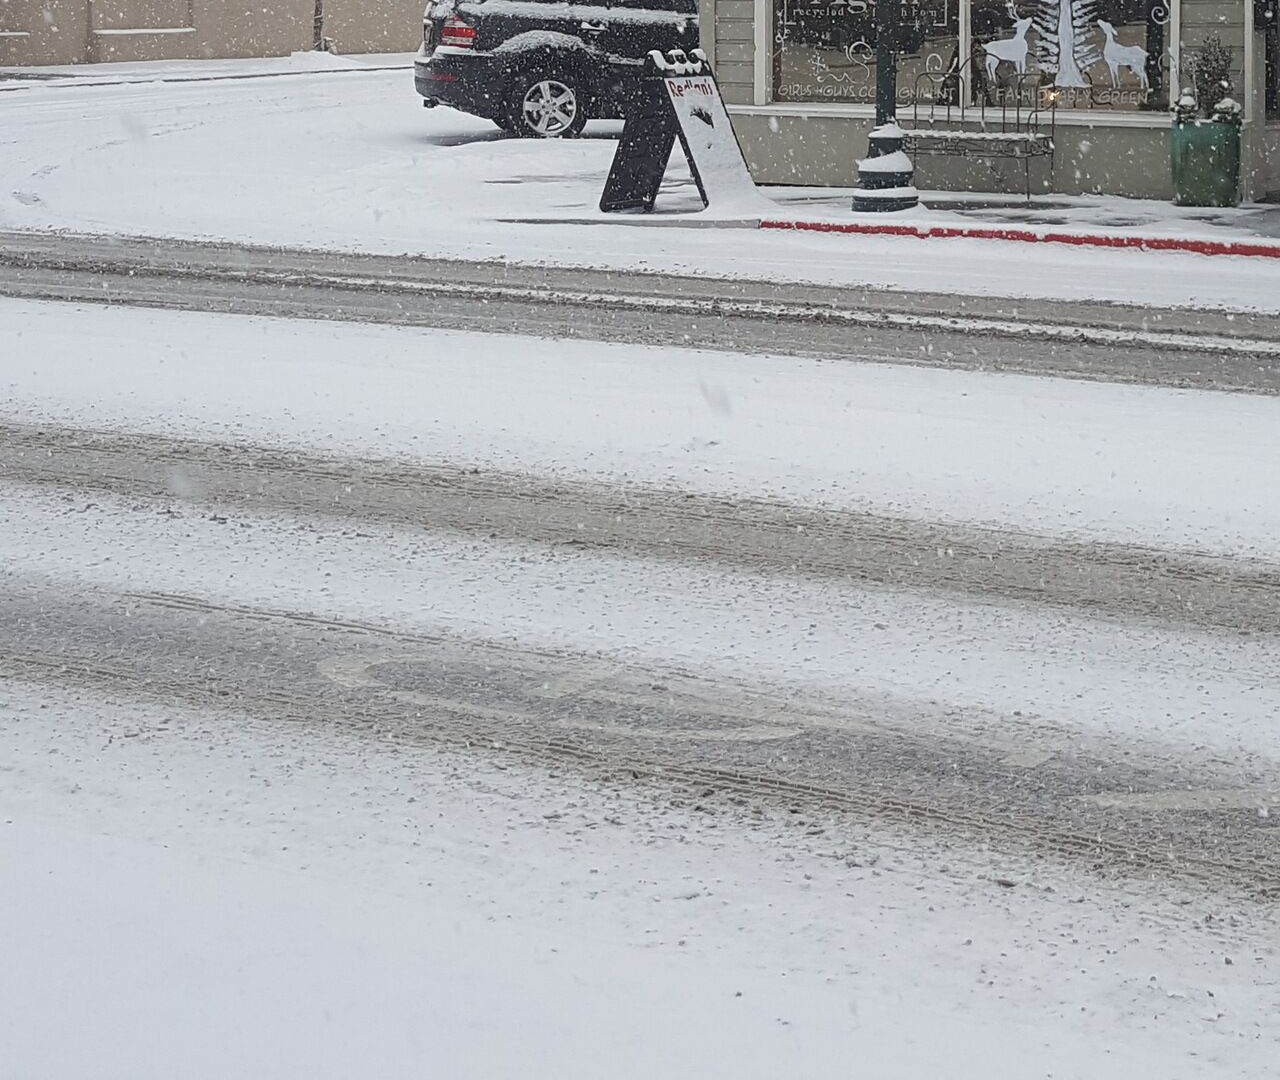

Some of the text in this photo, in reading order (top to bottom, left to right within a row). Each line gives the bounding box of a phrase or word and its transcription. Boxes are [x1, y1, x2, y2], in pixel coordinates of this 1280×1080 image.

[871, 6, 938, 18] fhion
[777, 84, 812, 97] GIRLS
[822, 84, 856, 97] GUYS
[995, 87, 1149, 106] FASHIOABLY GREEN
